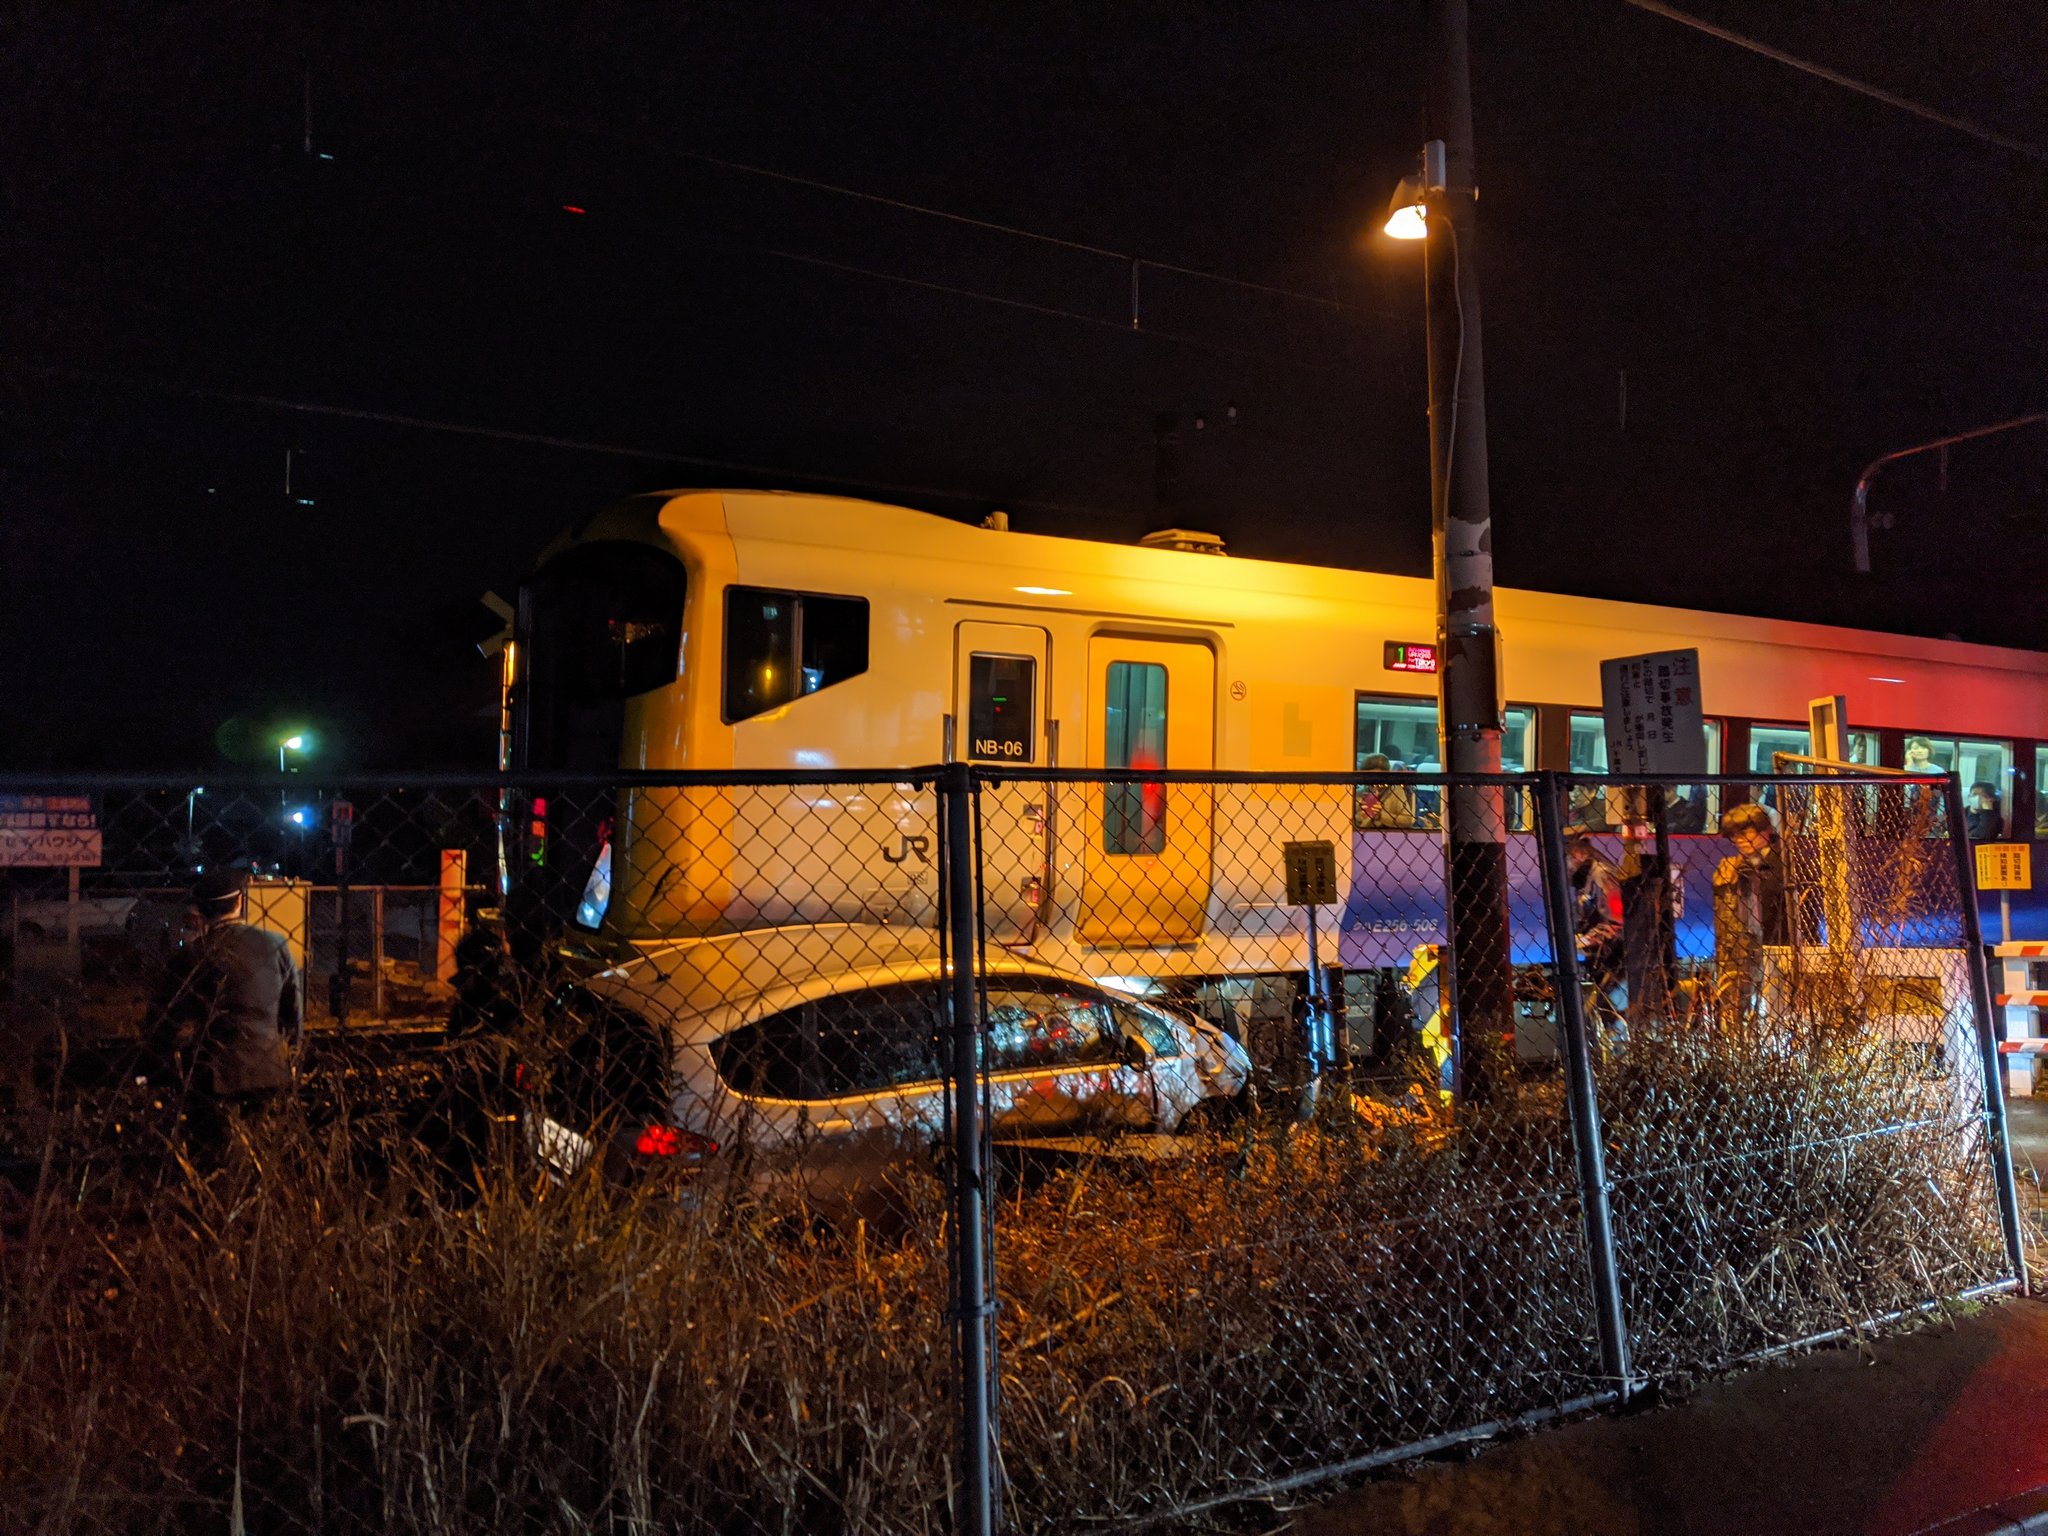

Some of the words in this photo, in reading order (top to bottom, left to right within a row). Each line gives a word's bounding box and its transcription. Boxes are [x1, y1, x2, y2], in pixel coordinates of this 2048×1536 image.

[1397, 647, 1404, 663] 1
[1673, 657, 1693, 706] 注意
[975, 740, 1023, 757] NB-06
[884, 836, 929, 862] JR
